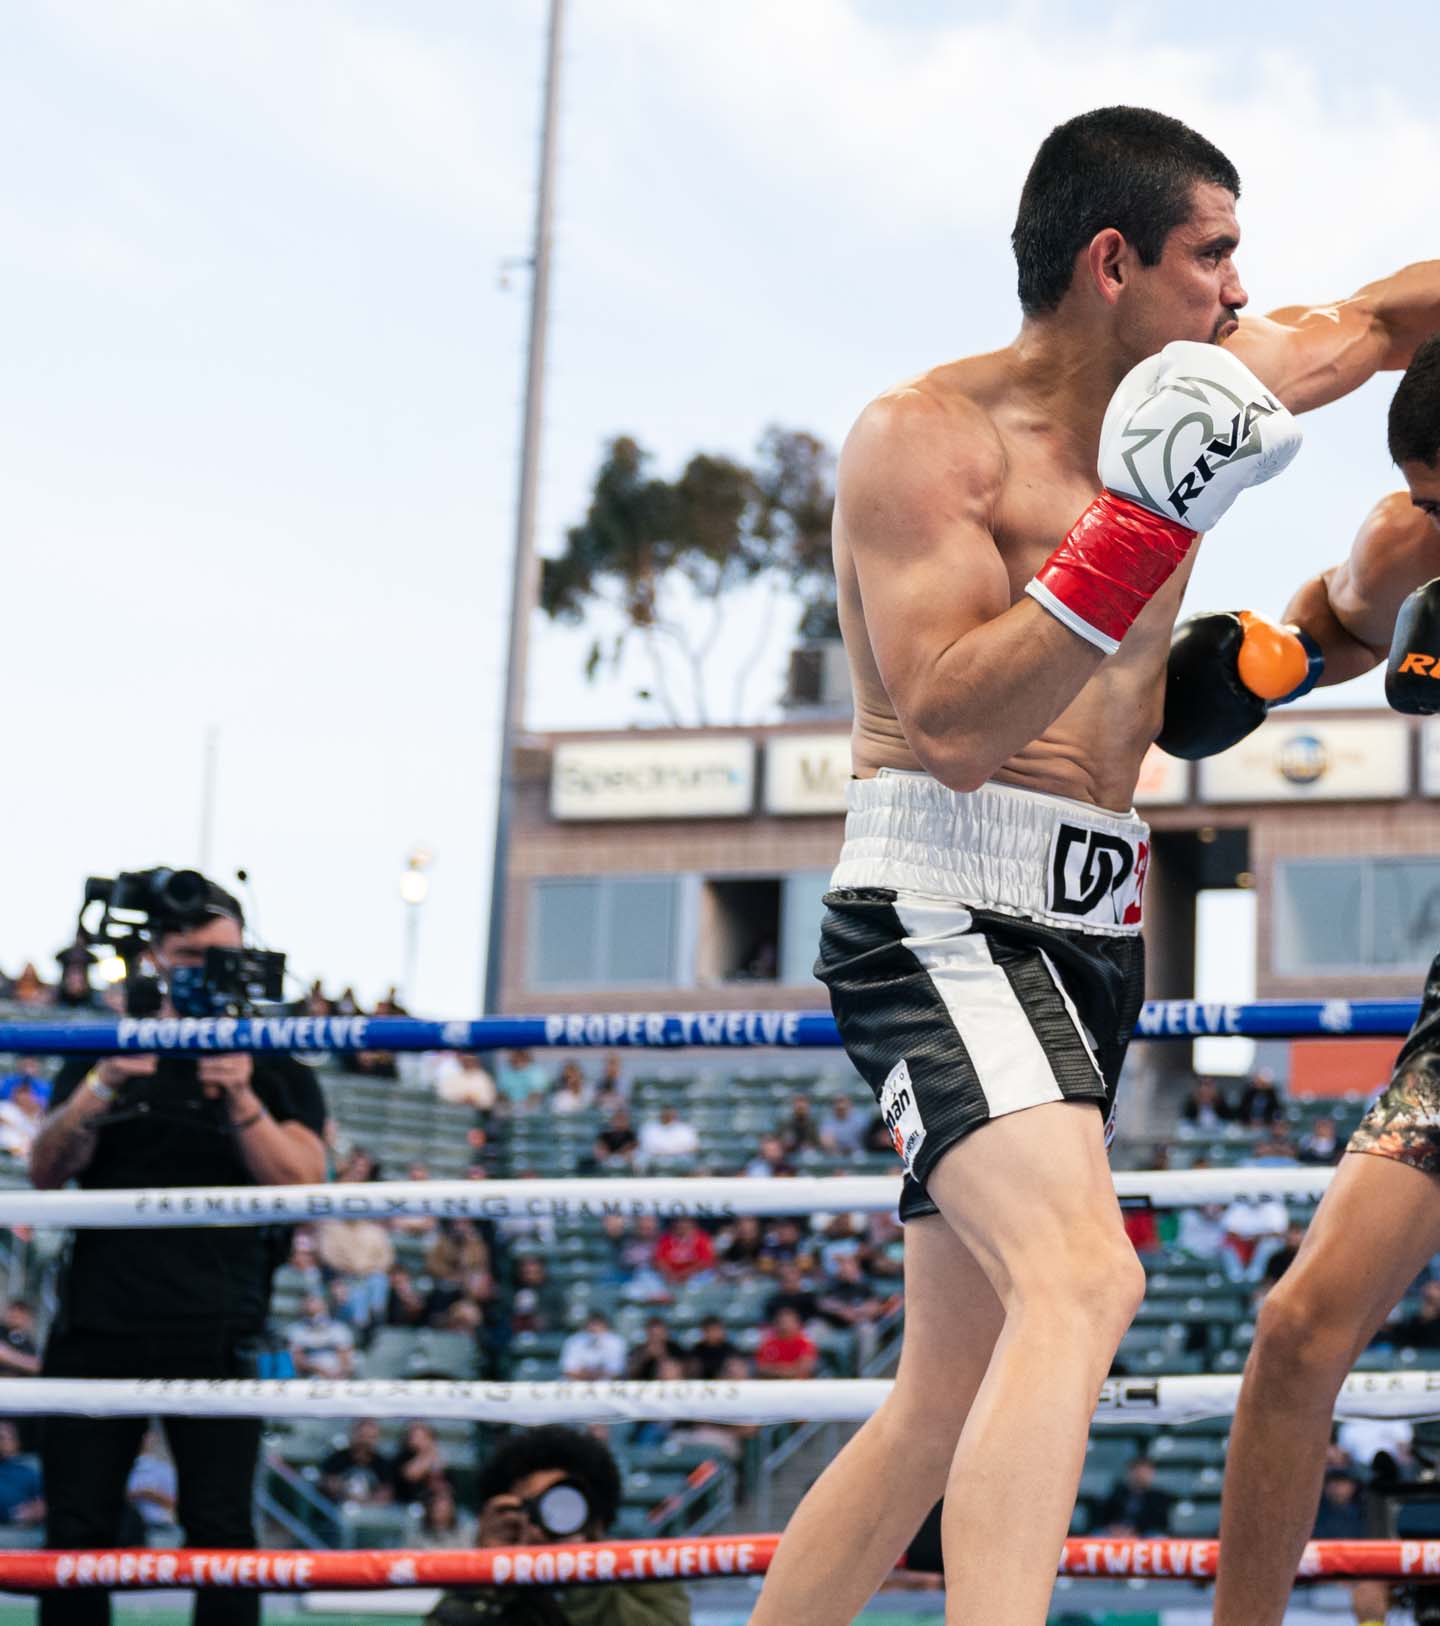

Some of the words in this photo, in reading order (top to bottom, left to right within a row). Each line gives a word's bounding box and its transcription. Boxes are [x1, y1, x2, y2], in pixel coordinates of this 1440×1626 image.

[116, 1016, 240, 1049] PROPER
[252, 1015, 370, 1048] TWELVE
[544, 1013, 667, 1046] PROPER
[680, 1012, 801, 1046] TWELVE
[1139, 1001, 1242, 1034] WELVE
[306, 1194, 510, 1217] BOXING
[55, 1555, 178, 1587] PROPER
[190, 1554, 316, 1587] TWELVE
[493, 1551, 617, 1584] PROPER
[630, 1543, 756, 1578] TWELVE
[1082, 1542, 1210, 1576] TWELVE
